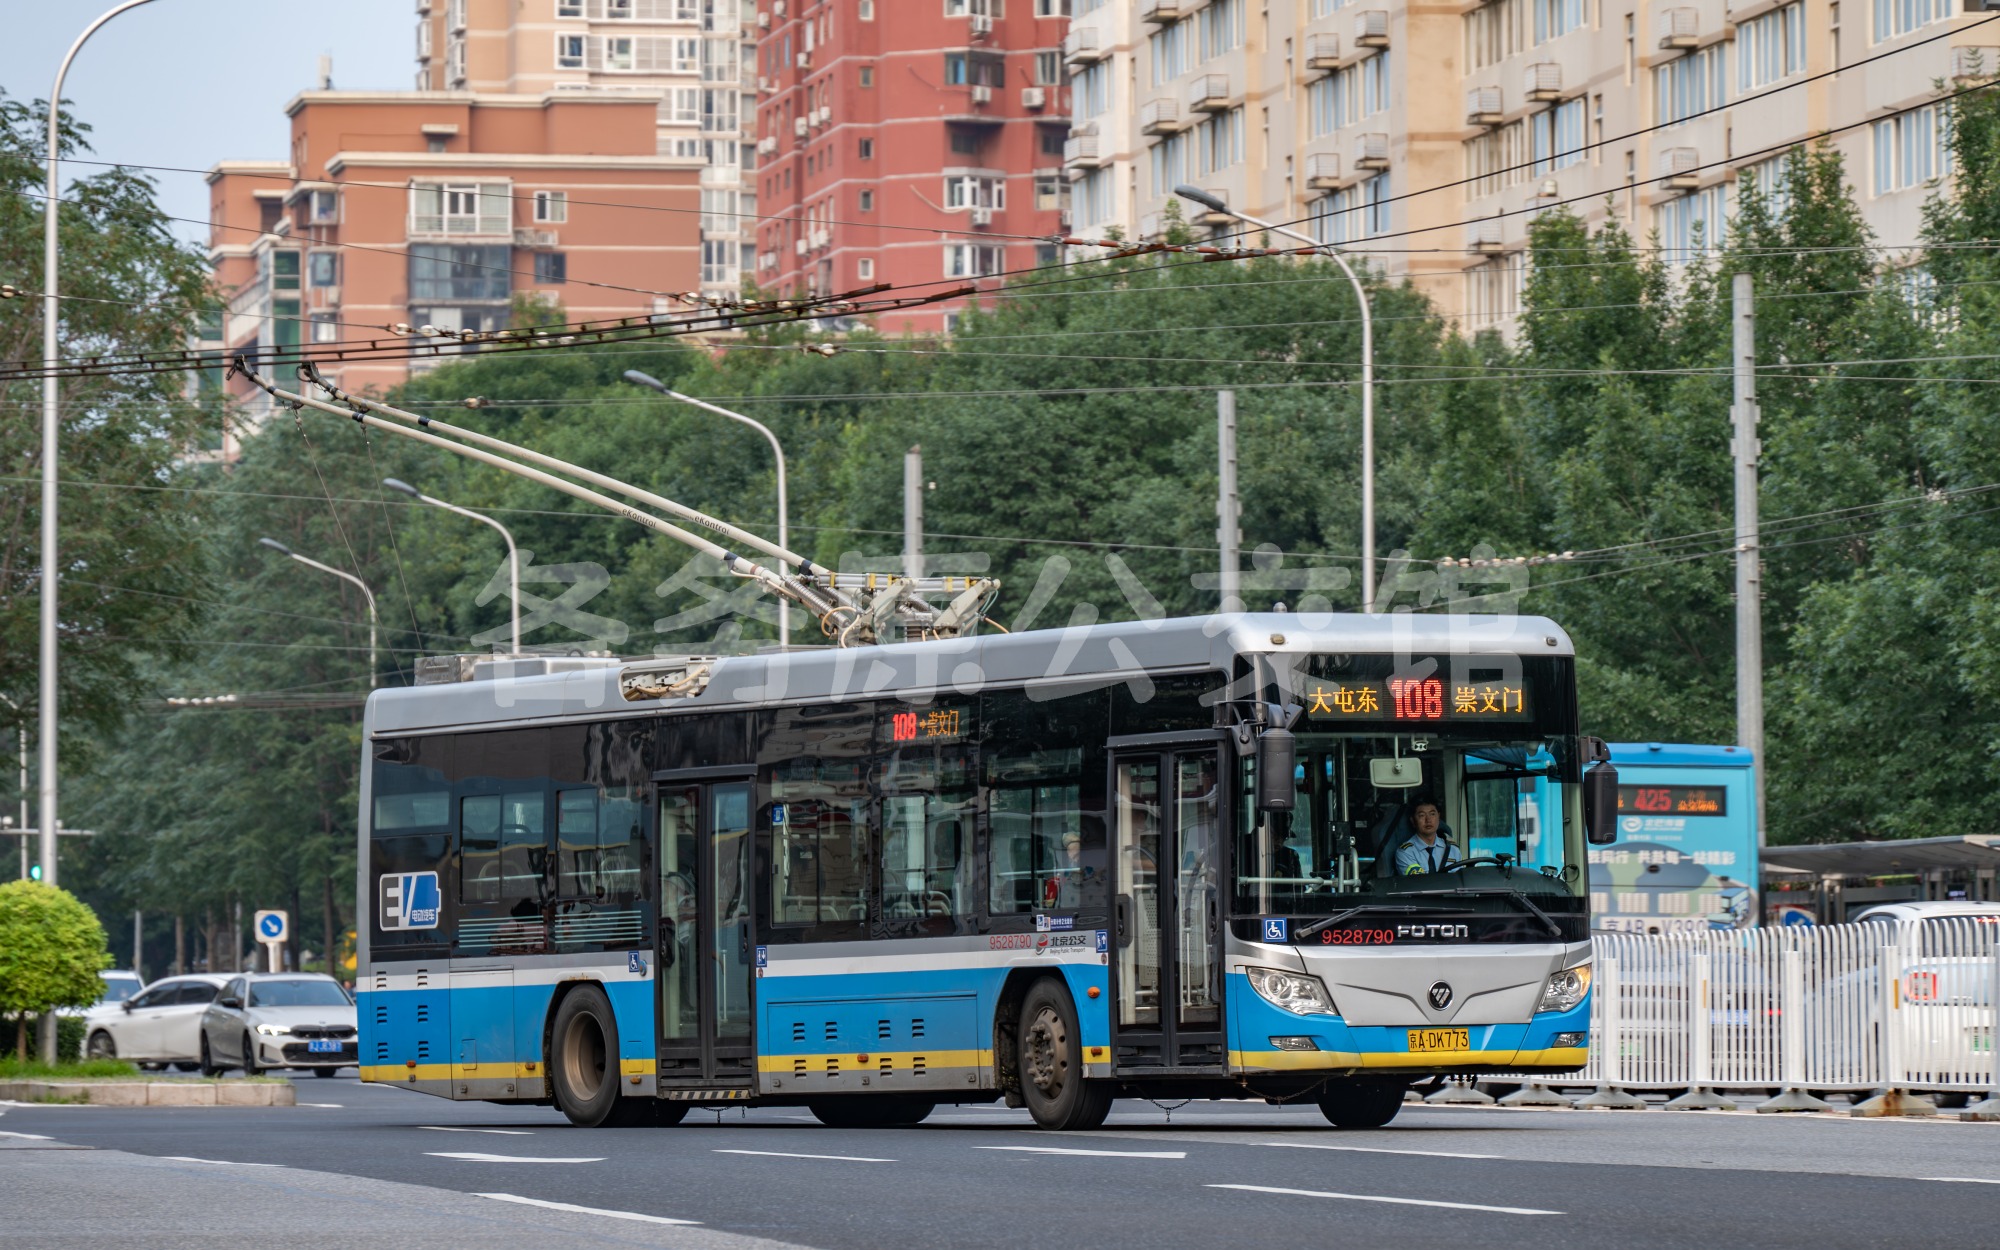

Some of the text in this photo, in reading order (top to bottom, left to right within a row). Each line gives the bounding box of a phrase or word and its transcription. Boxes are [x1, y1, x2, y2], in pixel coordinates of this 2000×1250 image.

[1309, 680, 1524, 719] 大屯东 108 崇文门
[892, 709, 959, 741] 108 崇文门
[1634, 788, 1672, 812] 425
[989, 934, 1032, 950] 9528790
[1050, 935, 1086, 947] 北京公交
[1321, 924, 1469, 945] 9528790 FOTON
[1409, 1031, 1469, 1049] 京A·DK773
